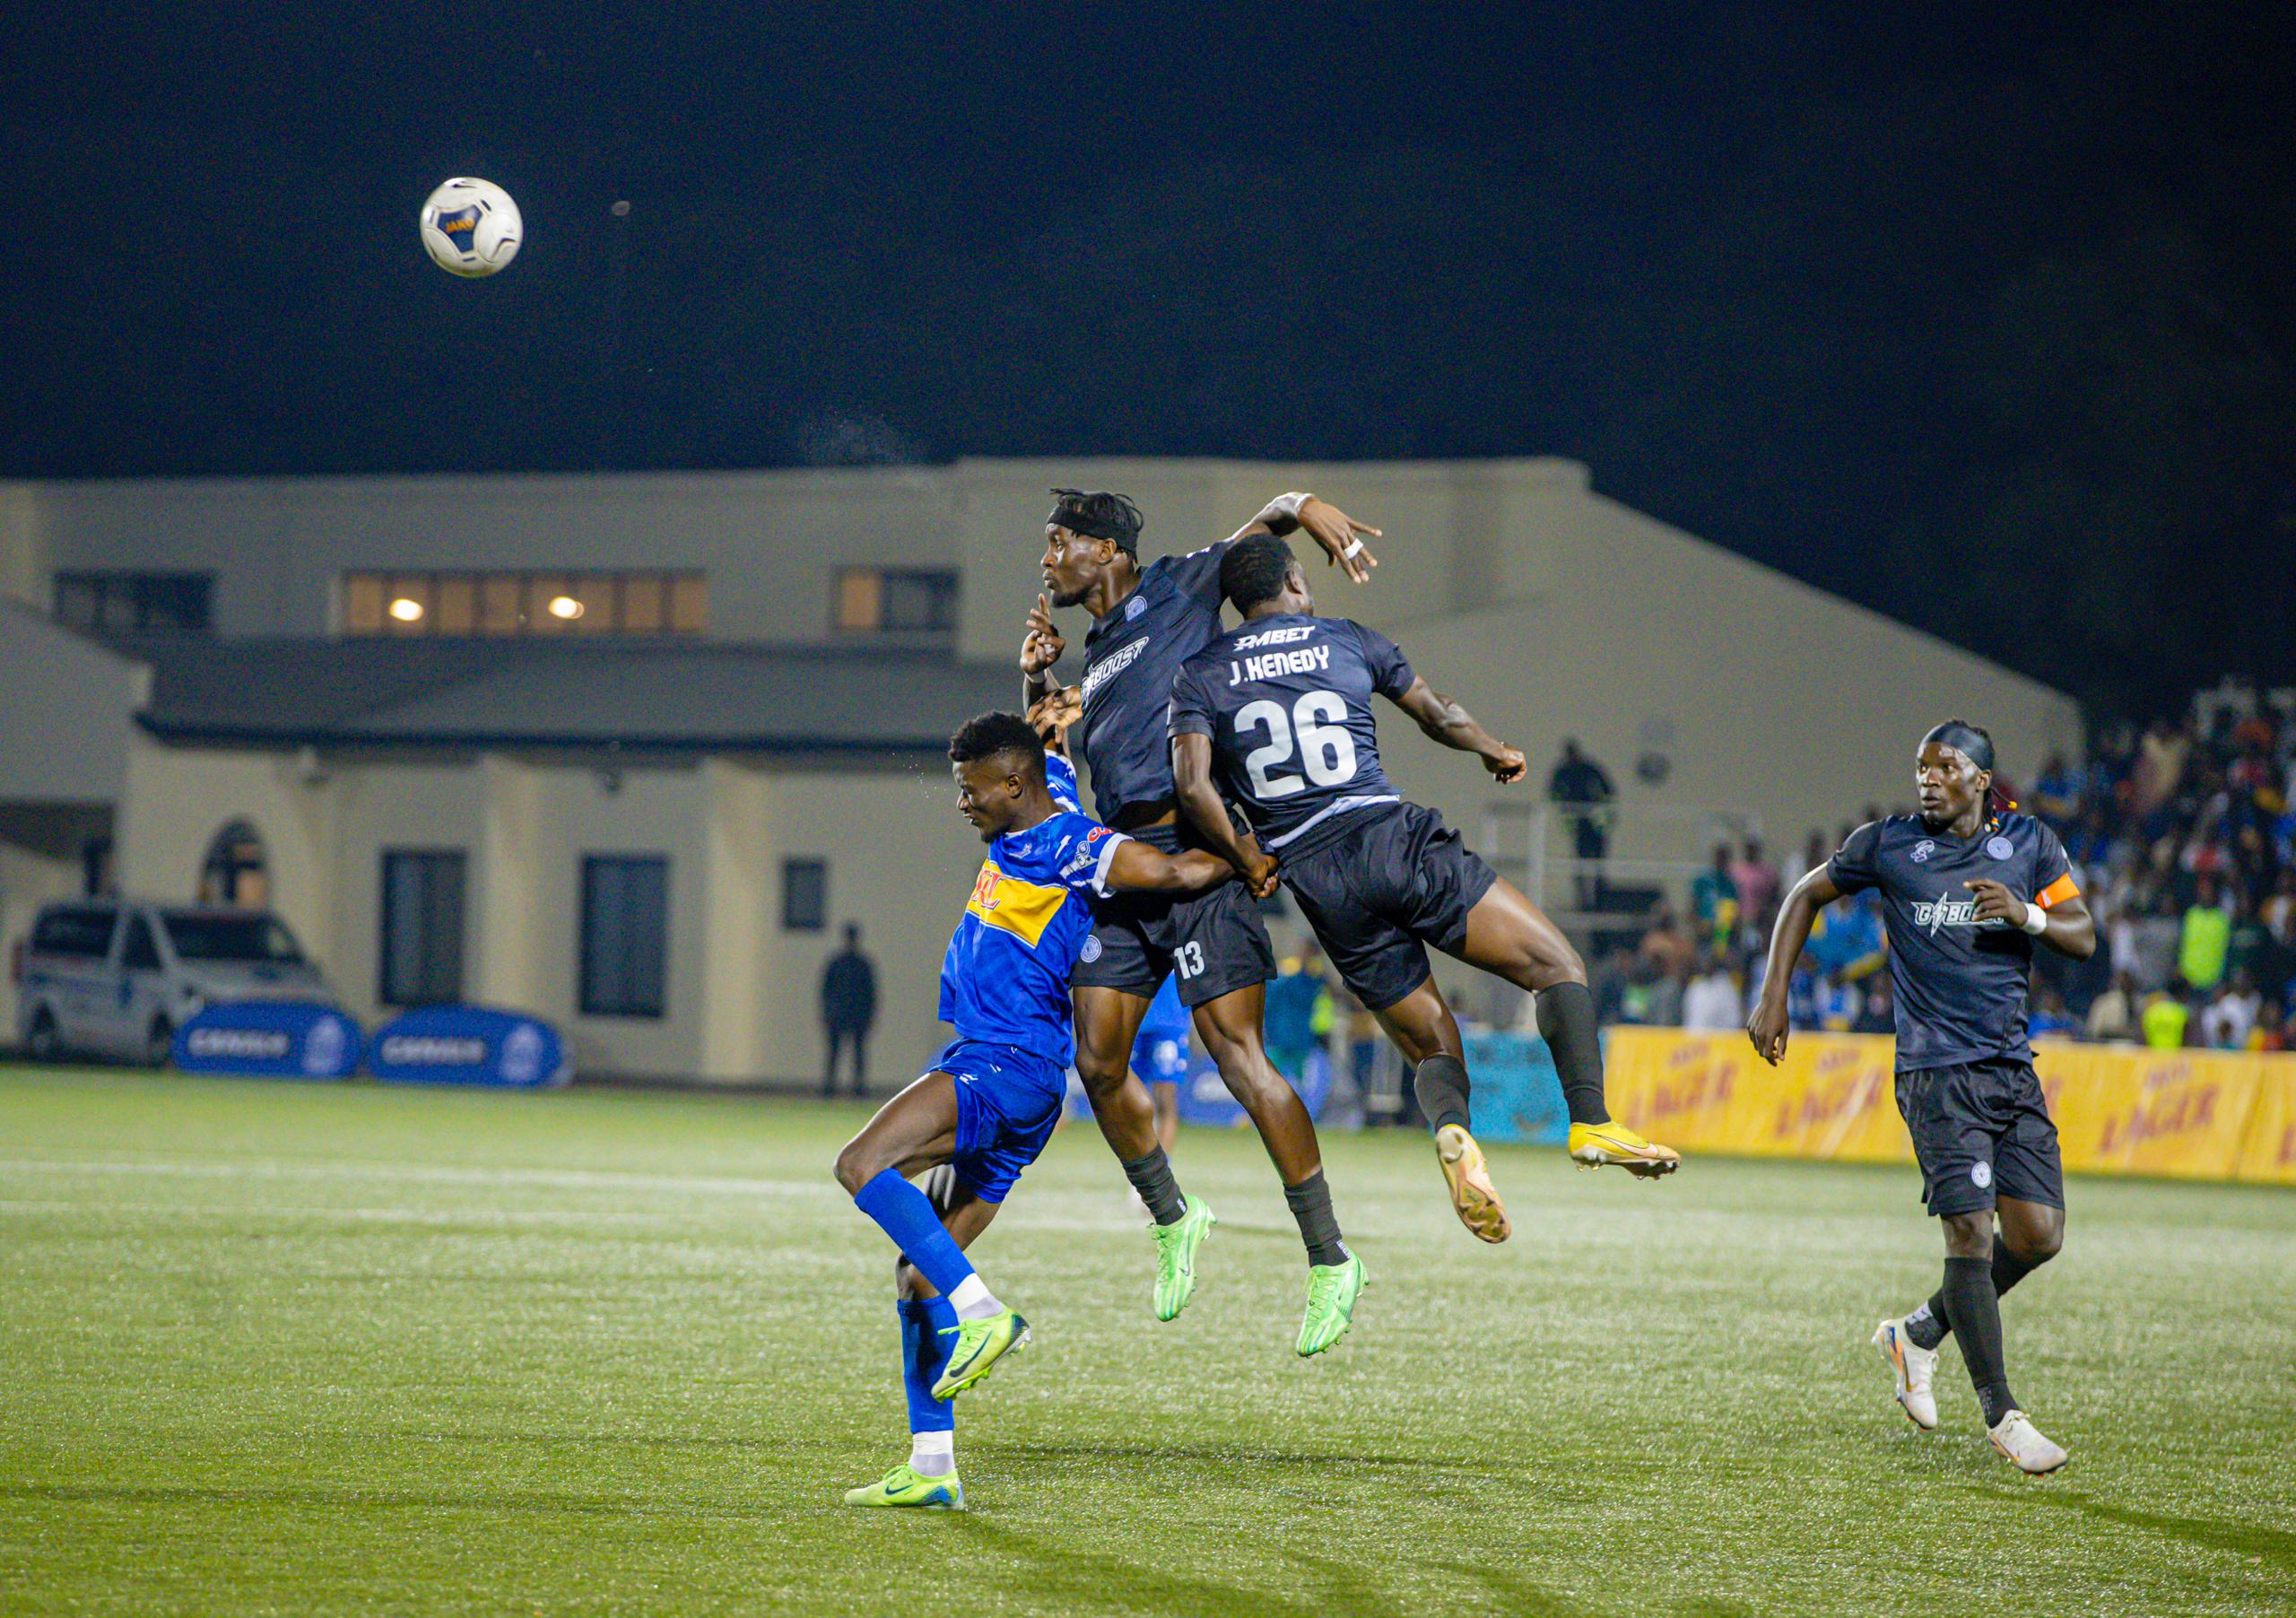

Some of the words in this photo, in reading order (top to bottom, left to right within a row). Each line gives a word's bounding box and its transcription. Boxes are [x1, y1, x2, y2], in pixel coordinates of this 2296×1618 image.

[1230, 645, 1329, 686] J.KENEDY
[1234, 690, 1357, 798] 26
[1174, 941, 1205, 979] 13
